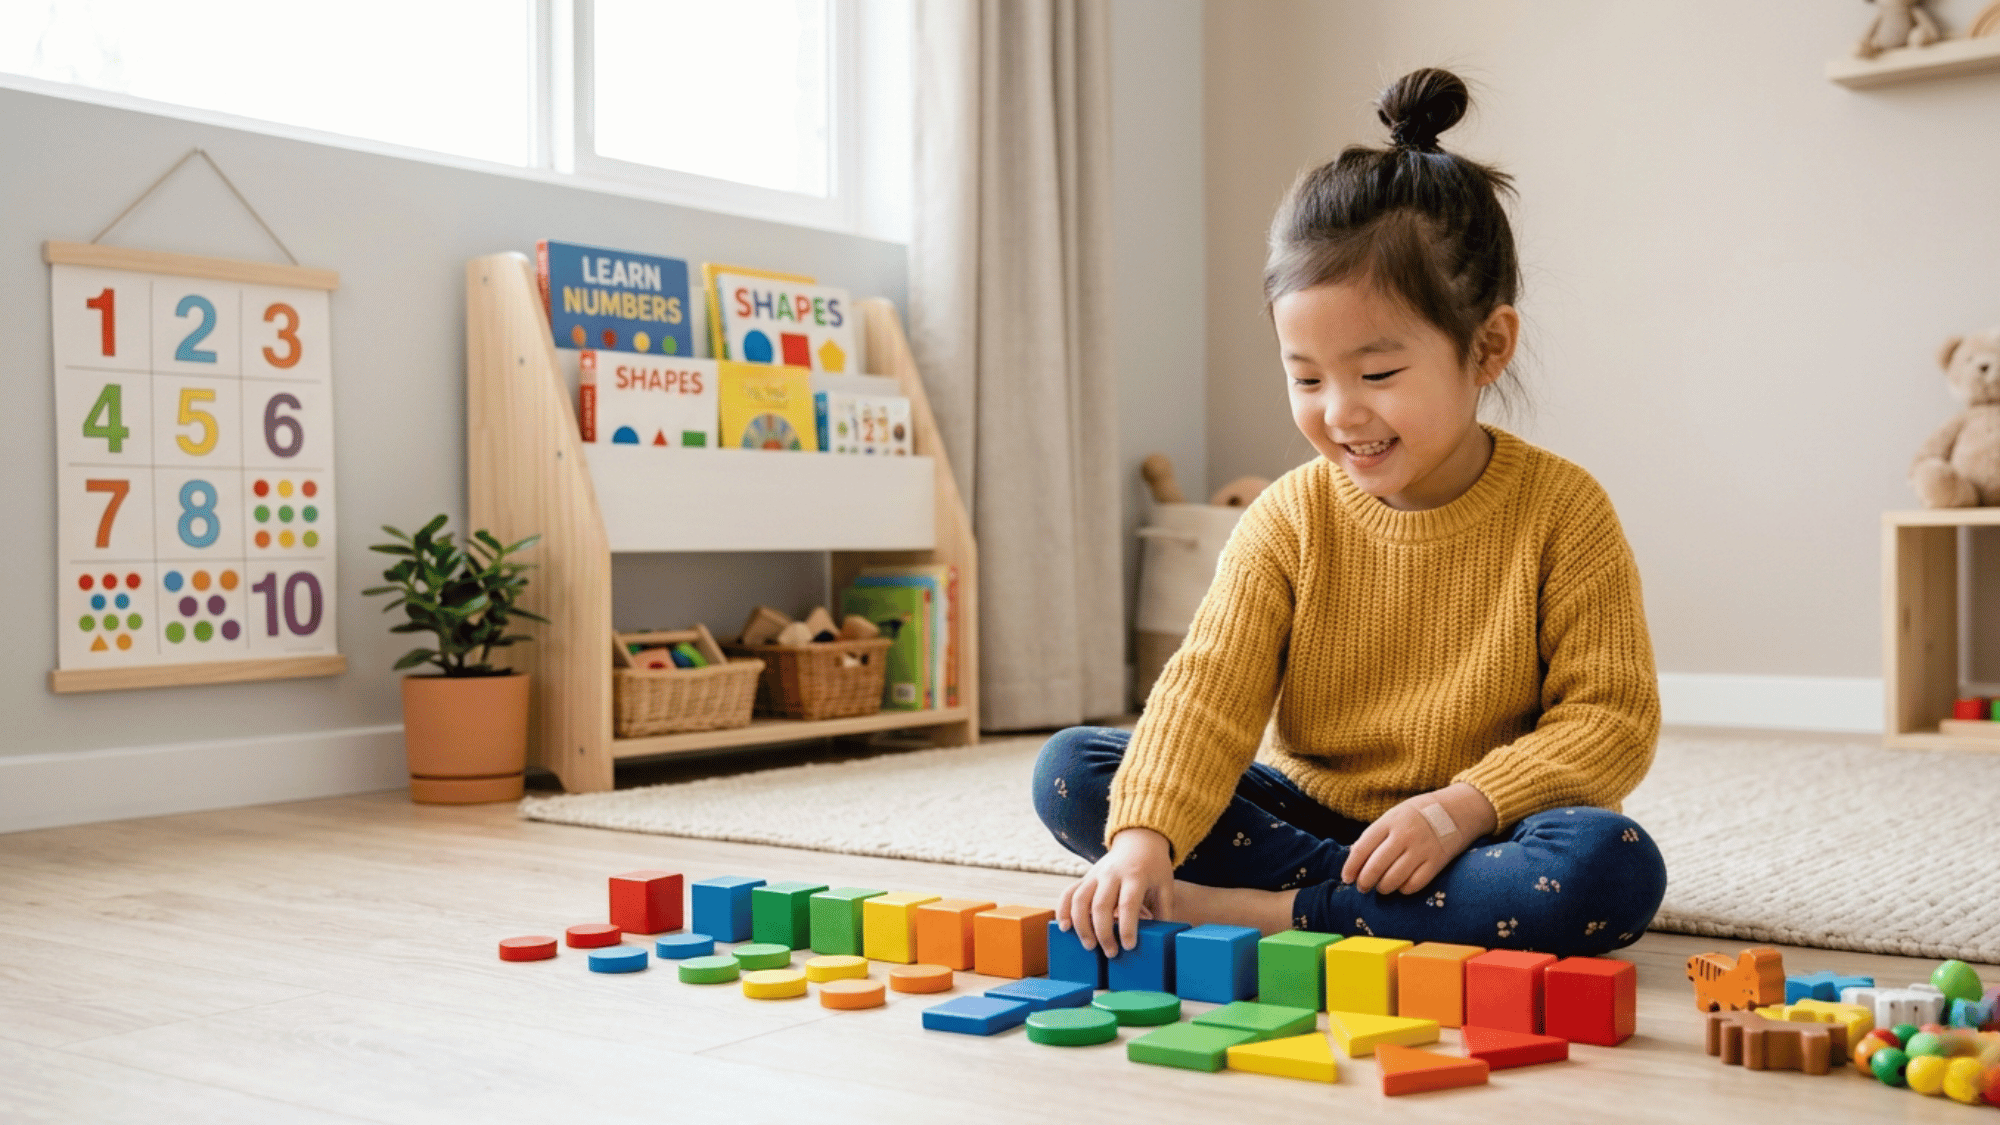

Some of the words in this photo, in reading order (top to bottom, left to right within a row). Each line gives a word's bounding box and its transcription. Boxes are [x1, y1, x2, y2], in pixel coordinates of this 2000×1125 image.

[581, 255, 662, 291] LEARN
[86, 288, 116, 357] 1
[175, 295, 217, 363] 2
[263, 303, 302, 369] 3
[562, 286, 683, 325] NUMBERS
[734, 287, 844, 327] SHAPES
[615, 365, 704, 395] SHAPES
[83, 384, 129, 453] 4
[175, 388, 219, 456] 5
[264, 393, 304, 458] 6
[85, 479, 130, 548] 7
[177, 479, 220, 548] 8
[251, 570, 324, 638] 10
